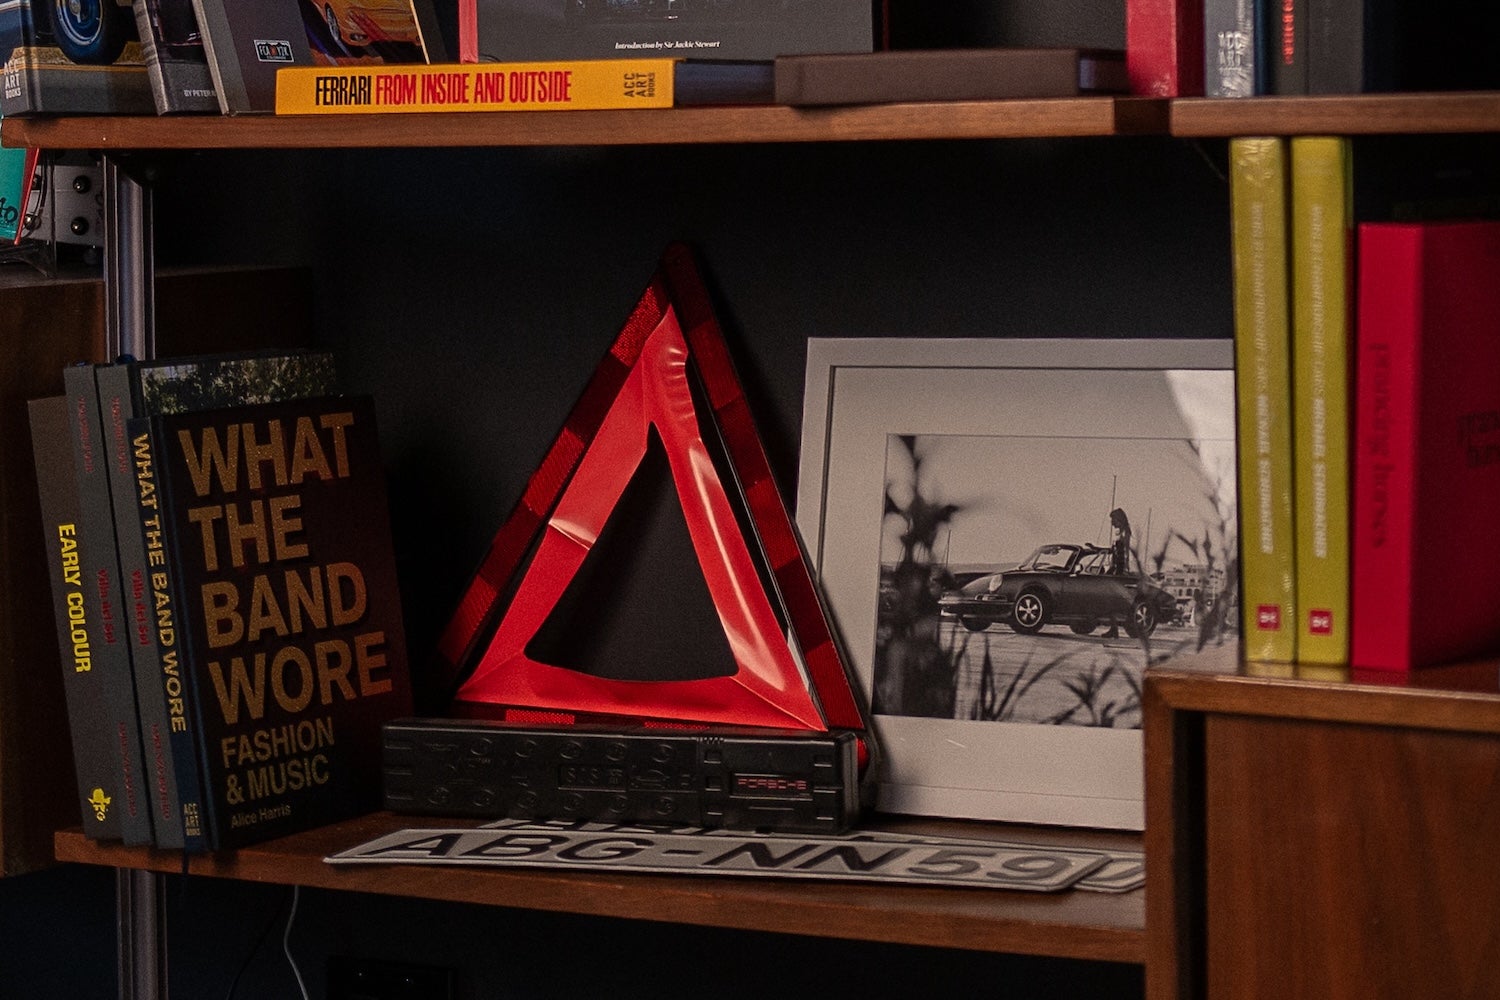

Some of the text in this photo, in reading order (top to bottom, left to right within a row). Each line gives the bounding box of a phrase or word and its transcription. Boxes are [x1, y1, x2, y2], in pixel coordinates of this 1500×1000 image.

[3, 61, 20, 73] ACC
[614, 40, 721, 50] Introduction by Sir Jackie Stewart
[5, 73, 20, 90] ART
[5, 89, 22, 100] BOOKS
[315, 71, 573, 106] FERRARI FROM INSIDE AND OUTSIDE
[624, 72, 635, 98] ACC
[635, 72, 647, 98] ART
[647, 72, 656, 98] BOOKS
[177, 411, 355, 497] WHAT
[187, 495, 310, 572] THE
[57, 523, 92, 673] EARLY COLOUR
[132, 433, 188, 733] WHAT THE BAND WORE
[201, 561, 369, 649] BAND
[98, 569, 116, 643] Villa del Sol
[132, 569, 150, 646] Villa del Sol
[208, 631, 393, 725] WORE
[220, 715, 335, 769] FASHION
[225, 752, 331, 805] & MUSIC
[736, 776, 809, 792] PORSCHE
[230, 802, 293, 830] Alice Harris
